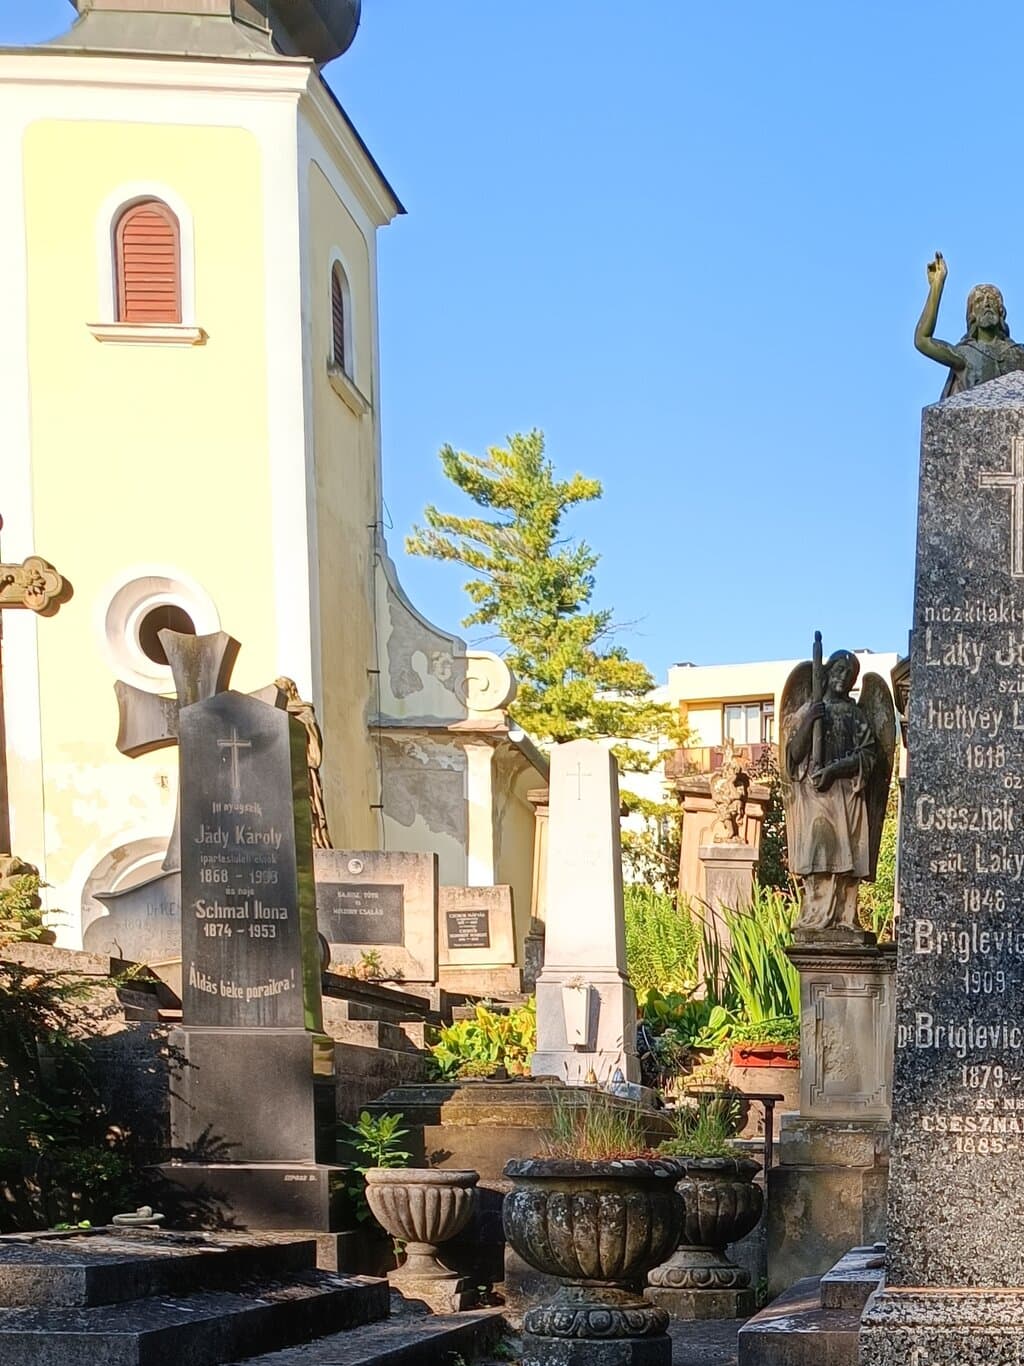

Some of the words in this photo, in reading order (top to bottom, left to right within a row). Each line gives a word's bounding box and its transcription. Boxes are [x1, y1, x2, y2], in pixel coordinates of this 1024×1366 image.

[925, 628, 984, 674] Laky
[195, 824, 229, 849] Jády
[236, 825, 282, 849] Károly
[975, 843, 1024, 881] Laky
[200, 868, 228, 883] 1868
[195, 899, 249, 920] Schmal
[254, 900, 289, 920] Ilona
[203, 923, 232, 938] 1874
[249, 924, 277, 938] 1953
[219, 980, 244, 999] béke
